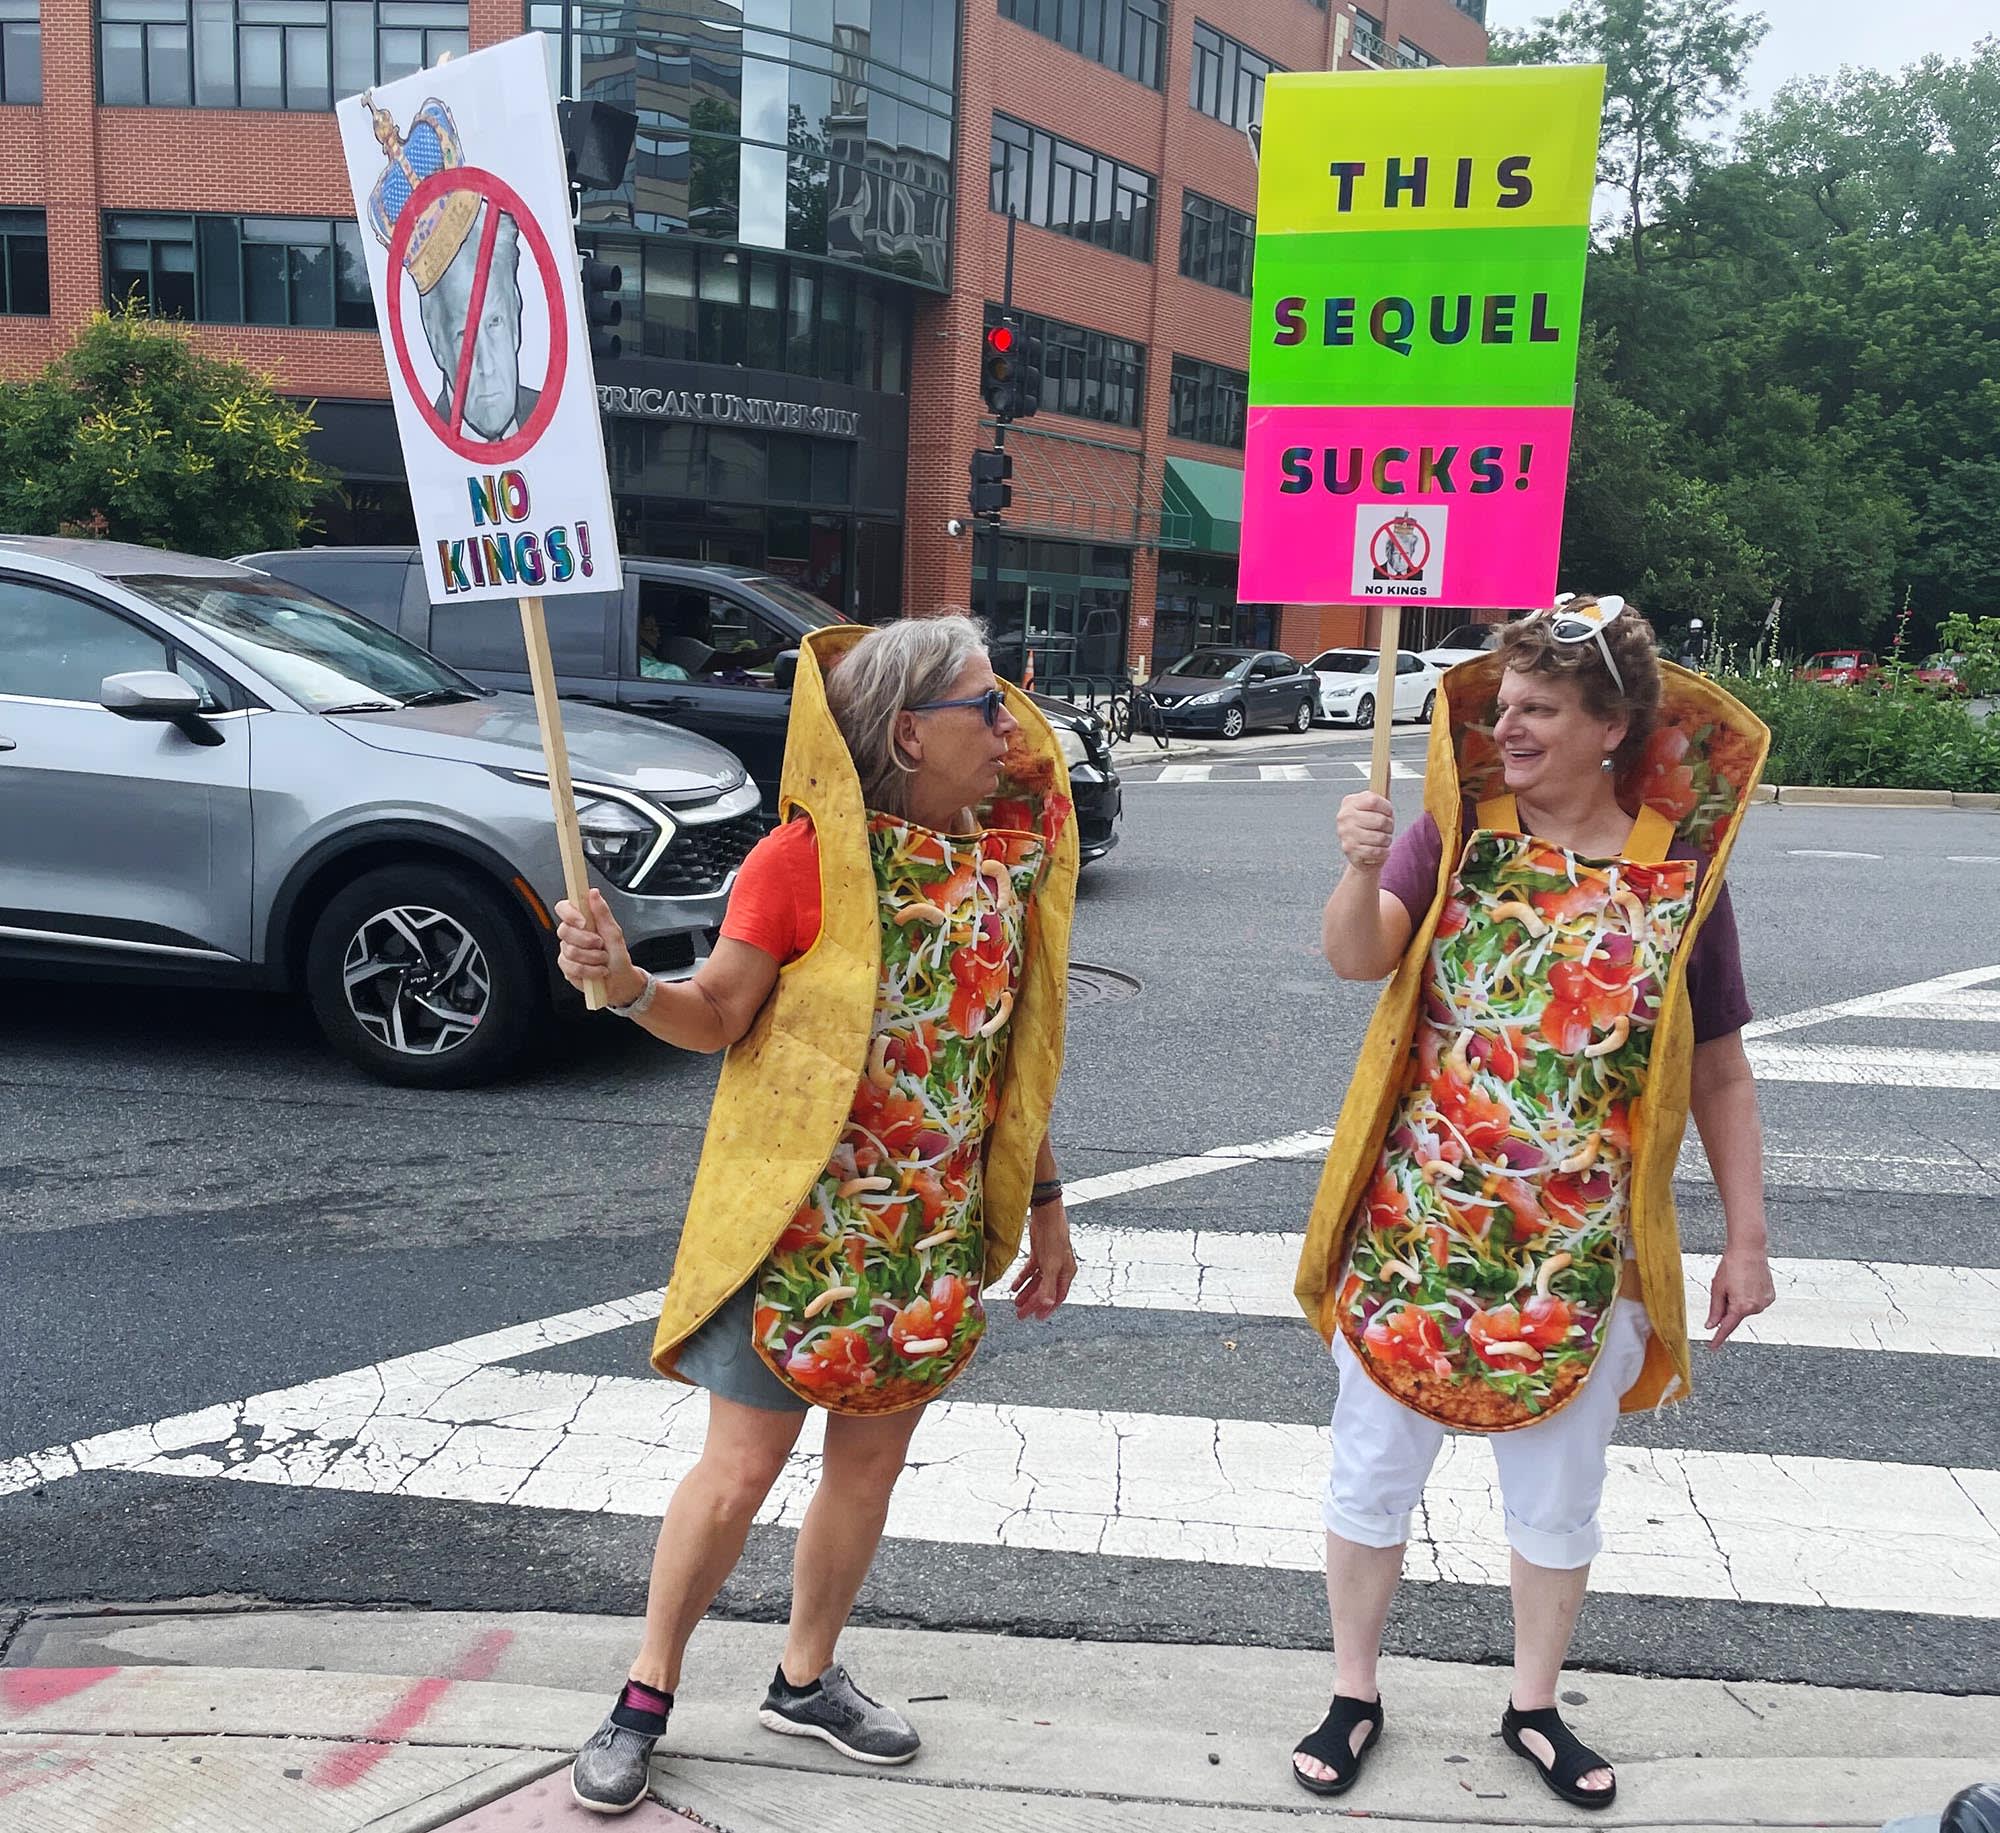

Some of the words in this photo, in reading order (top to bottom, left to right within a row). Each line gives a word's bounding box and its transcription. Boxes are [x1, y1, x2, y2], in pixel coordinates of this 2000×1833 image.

[1329, 155, 1533, 213] THIS
[1273, 292, 1560, 358] SEQUEL
[595, 384, 705, 420] ERICAN
[710, 392, 862, 437] UNIVERSITY
[466, 469, 531, 527] NO
[1279, 444, 1534, 495] SUCKS!
[436, 520, 594, 595] KINGS!
[1364, 585, 1383, 595] NO
[1387, 585, 1428, 596] KINGS
